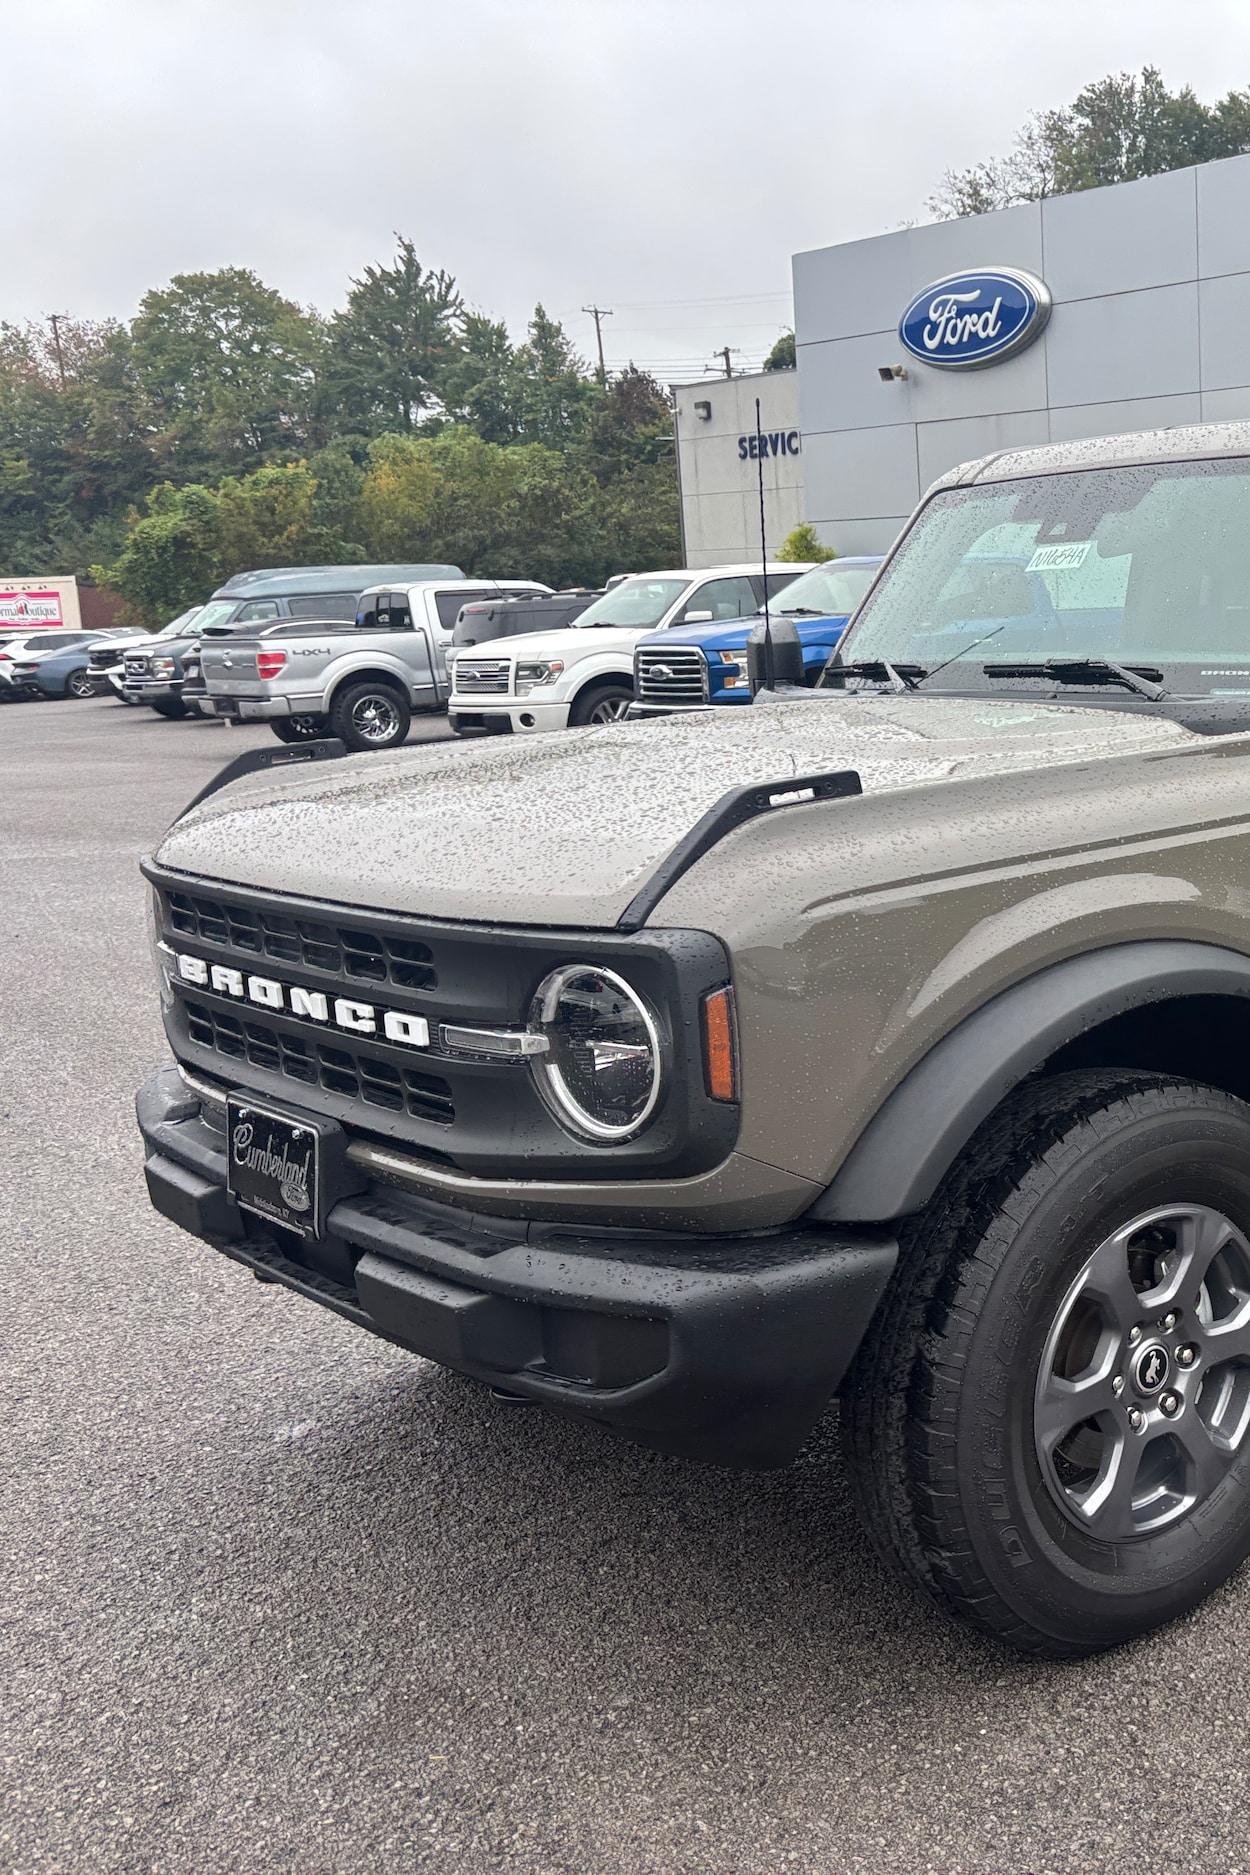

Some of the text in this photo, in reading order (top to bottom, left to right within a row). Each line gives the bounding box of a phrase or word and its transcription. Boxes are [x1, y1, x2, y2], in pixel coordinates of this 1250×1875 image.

[922, 289, 1003, 350] Ford
[738, 431, 802, 460] SERVIC
[179, 954, 430, 1047] BRONCO
[233, 1123, 312, 1191] Cumberland
